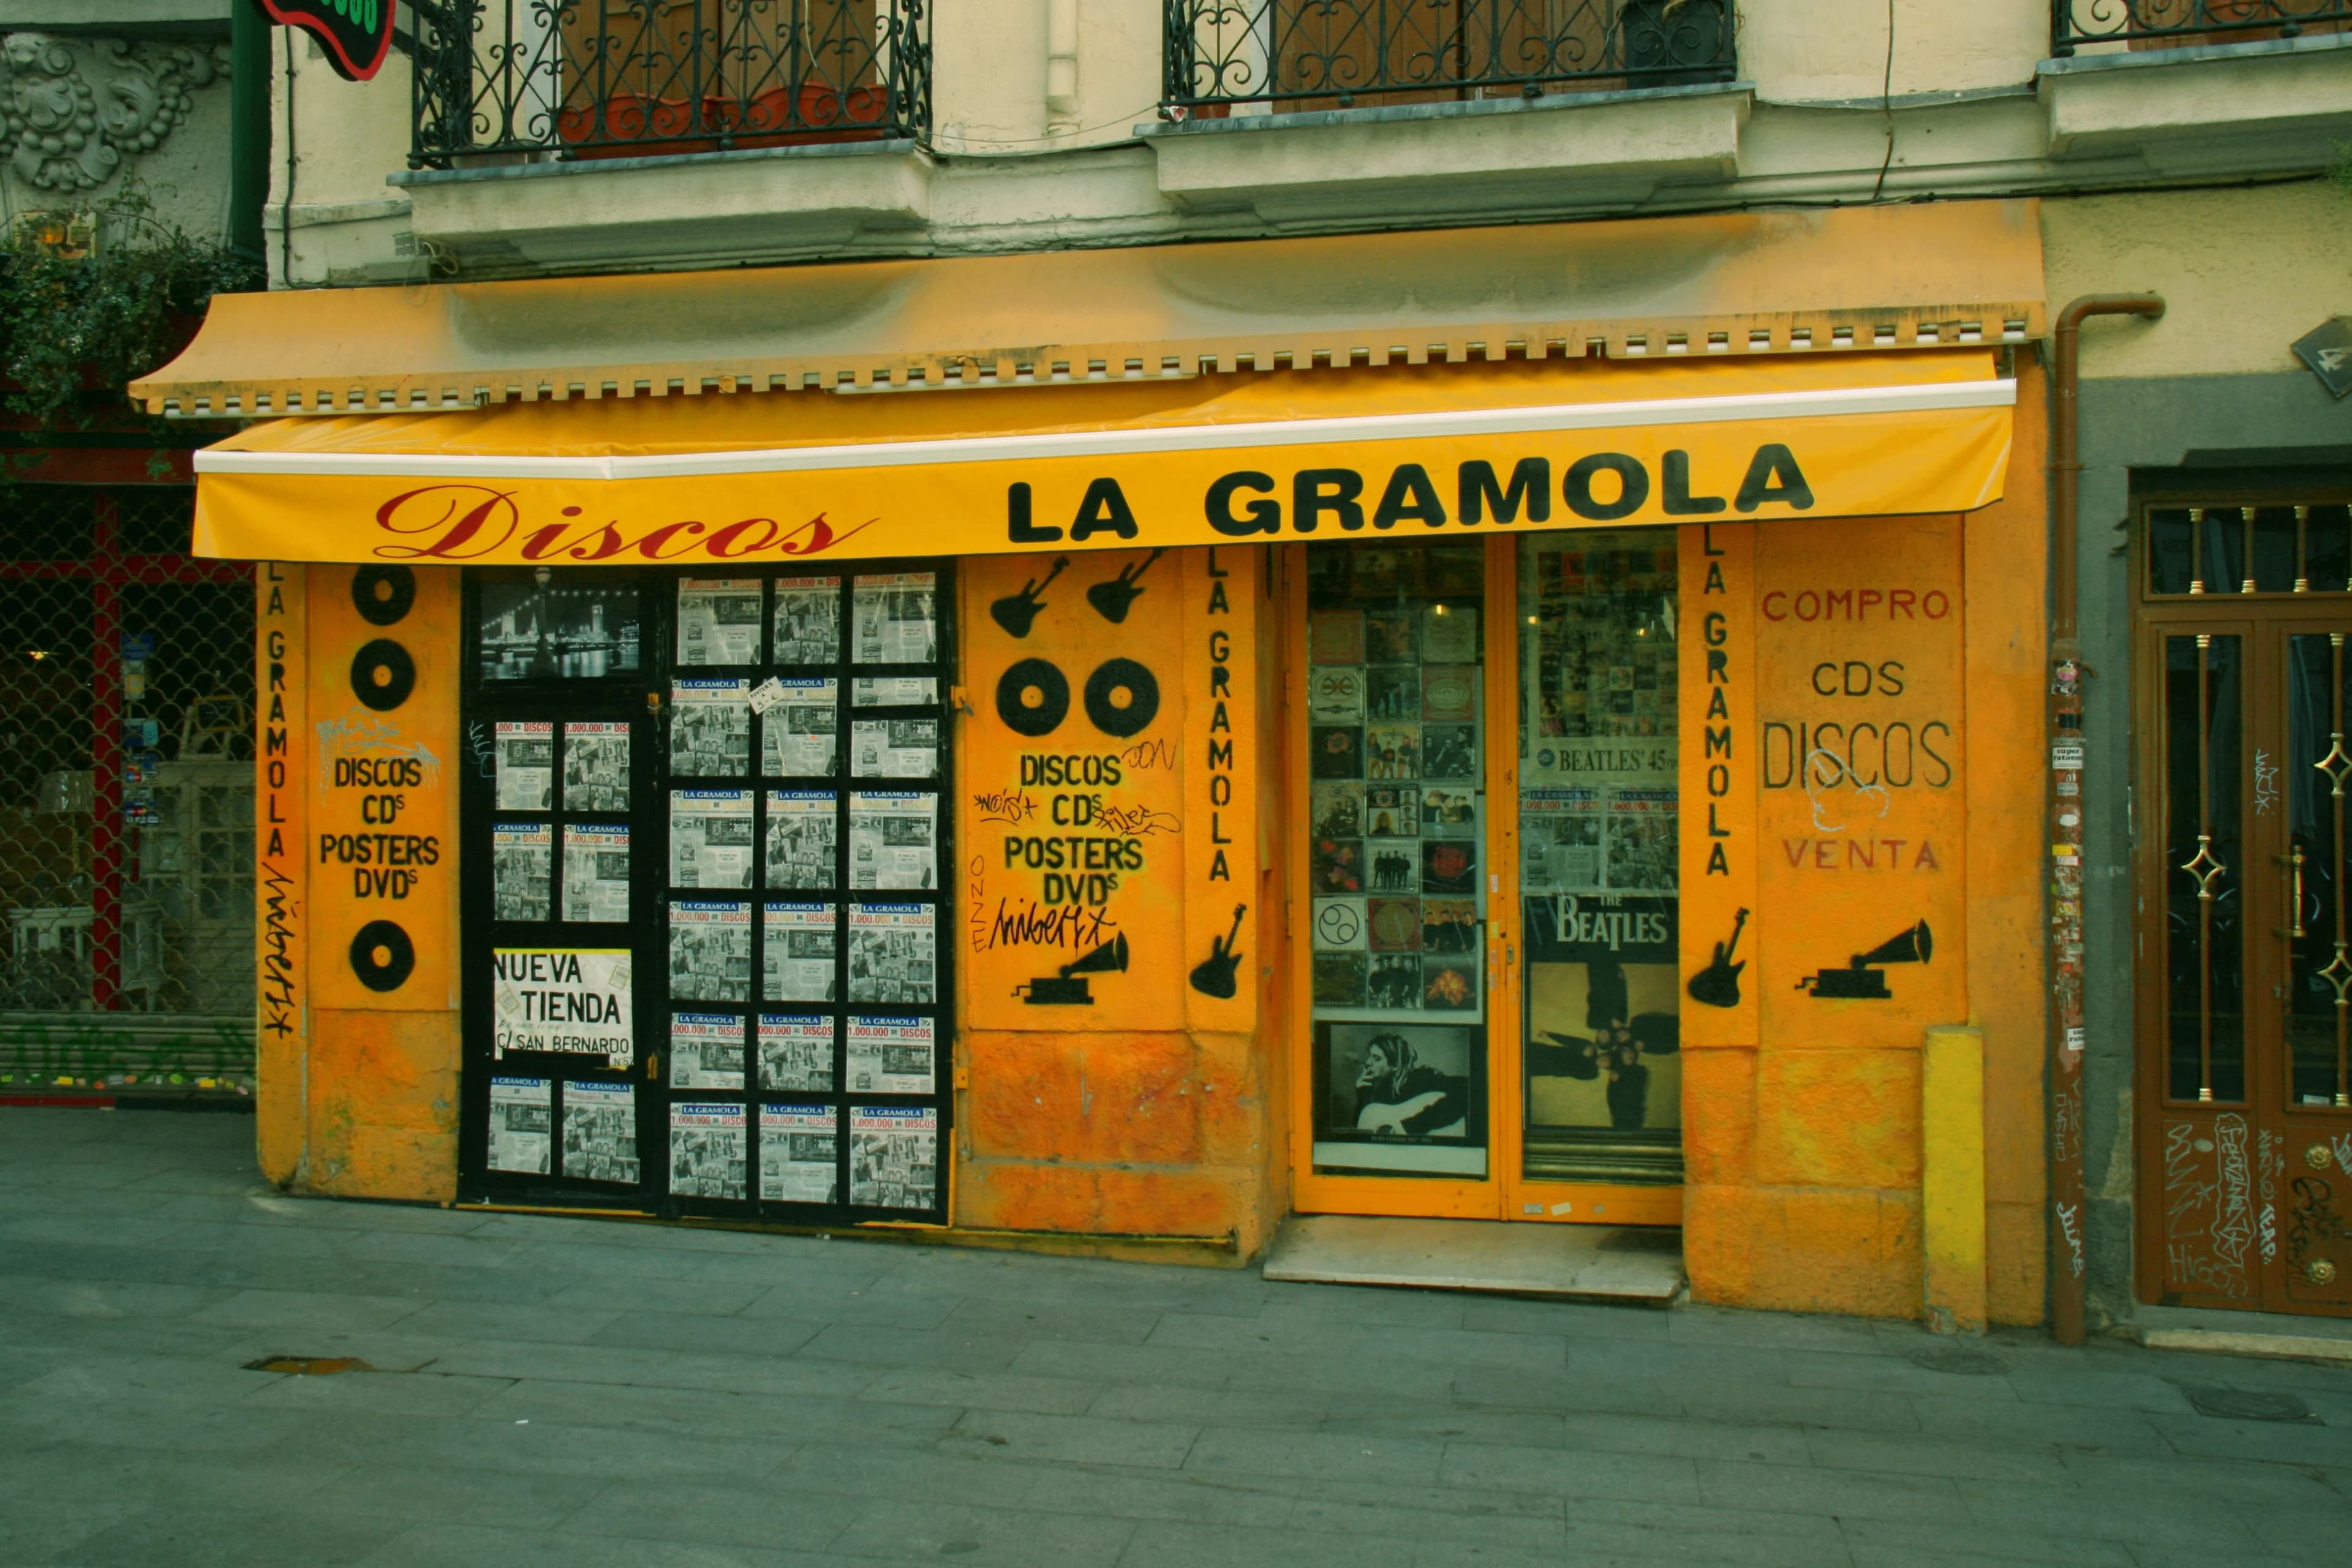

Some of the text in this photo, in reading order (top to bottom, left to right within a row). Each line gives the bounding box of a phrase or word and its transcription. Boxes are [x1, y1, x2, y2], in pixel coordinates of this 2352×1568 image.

[1008, 443, 1815, 543] LA GRAMOLA
[373, 484, 880, 560] Discos
[1762, 589, 1949, 622] COMPRO
[1812, 660, 1905, 697] CDS
[266, 562, 287, 857] LA GRAMOLA
[1207, 546, 1233, 882] LA GRAMOLA
[1703, 522, 1732, 876] LA GRAMOLA
[524, 723, 553, 733] DISCOS
[565, 723, 603, 733] 1.000.000
[1020, 755, 1121, 786] DISCOS
[1763, 721, 1952, 790] DISCOS
[335, 758, 422, 787] DISCOS
[320, 834, 439, 865] POSTERS
[523, 834, 551, 843] DISCOS
[1005, 836, 1143, 870] POSTERS
[1782, 839, 1940, 870] VENTA
[1599, 894, 1622, 907] THE
[669, 912, 709, 921] 1.000.000
[722, 913, 750, 922] DISCOS
[806, 913, 836, 922] DISCOS
[850, 914, 892, 924] 1.000.000
[903, 915, 933, 925] DISCOS
[492, 953, 582, 984] NUEVA
[521, 990, 621, 1024] TIENDA
[497, 1030, 629, 1054] C/ SAN BERNARDO
[803, 1027, 833, 1036] DISCOS
[848, 1027, 888, 1036] 1.000.000
[900, 1028, 931, 1038] DISCOS
[587, 1083, 628, 1091] GRAMOLA
[807, 1117, 837, 1126] DISCOS
[852, 1118, 892, 1128] 1.000.000
[905, 1119, 936, 1128] DISCOS
